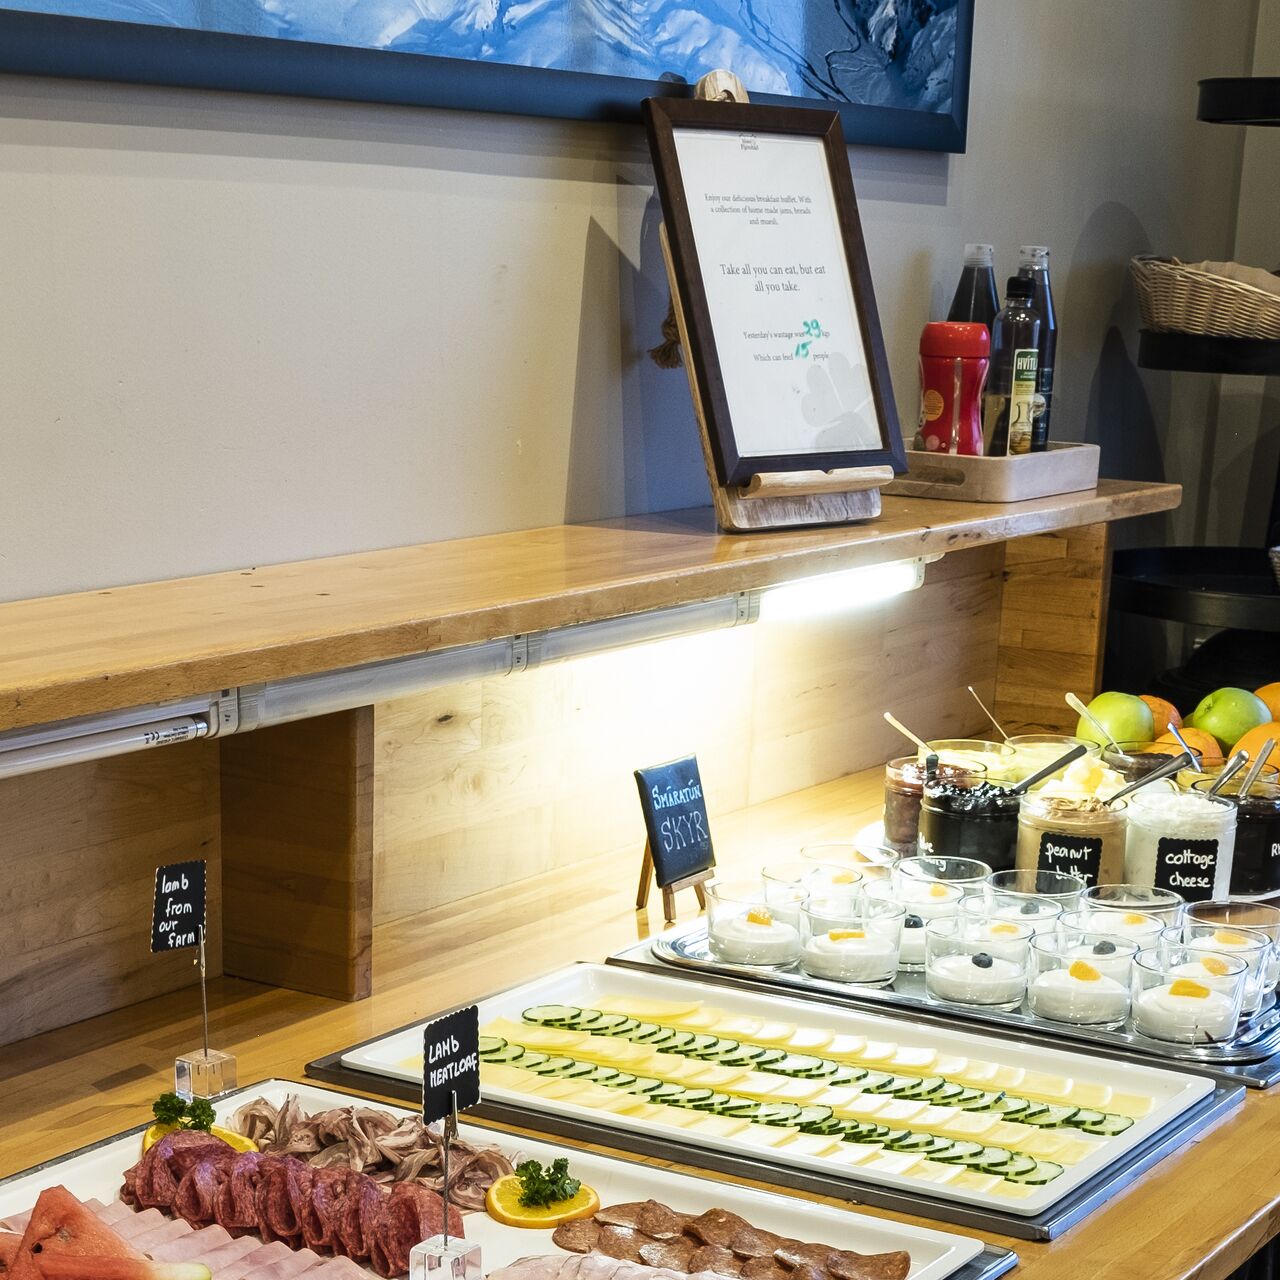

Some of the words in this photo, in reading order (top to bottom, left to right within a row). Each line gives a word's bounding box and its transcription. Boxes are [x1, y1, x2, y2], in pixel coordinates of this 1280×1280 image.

[714, 205, 741, 214] collection
[748, 205, 764, 214] home
[764, 206, 779, 214] made
[720, 263, 740, 275] Take
[741, 263, 751, 275] all
[753, 266, 768, 279] you
[770, 266, 784, 275] can
[799, 263, 813, 275] but
[814, 265, 826, 275] eat
[754, 280, 764, 291] all
[765, 283, 780, 295] you
[781, 280, 800, 292] take.
[743, 330, 773, 341] Yesterday's
[753, 351, 771, 361] Which
[661, 811, 708, 853] SKYR
[1045, 842, 1093, 863] peanut
[1165, 849, 1215, 870] cottage
[161, 872, 190, 894] lamb
[1169, 871, 1212, 888] cheese
[165, 897, 192, 918] from
[159, 920, 179, 933] our
[430, 1052, 478, 1088] MEATLOAF
